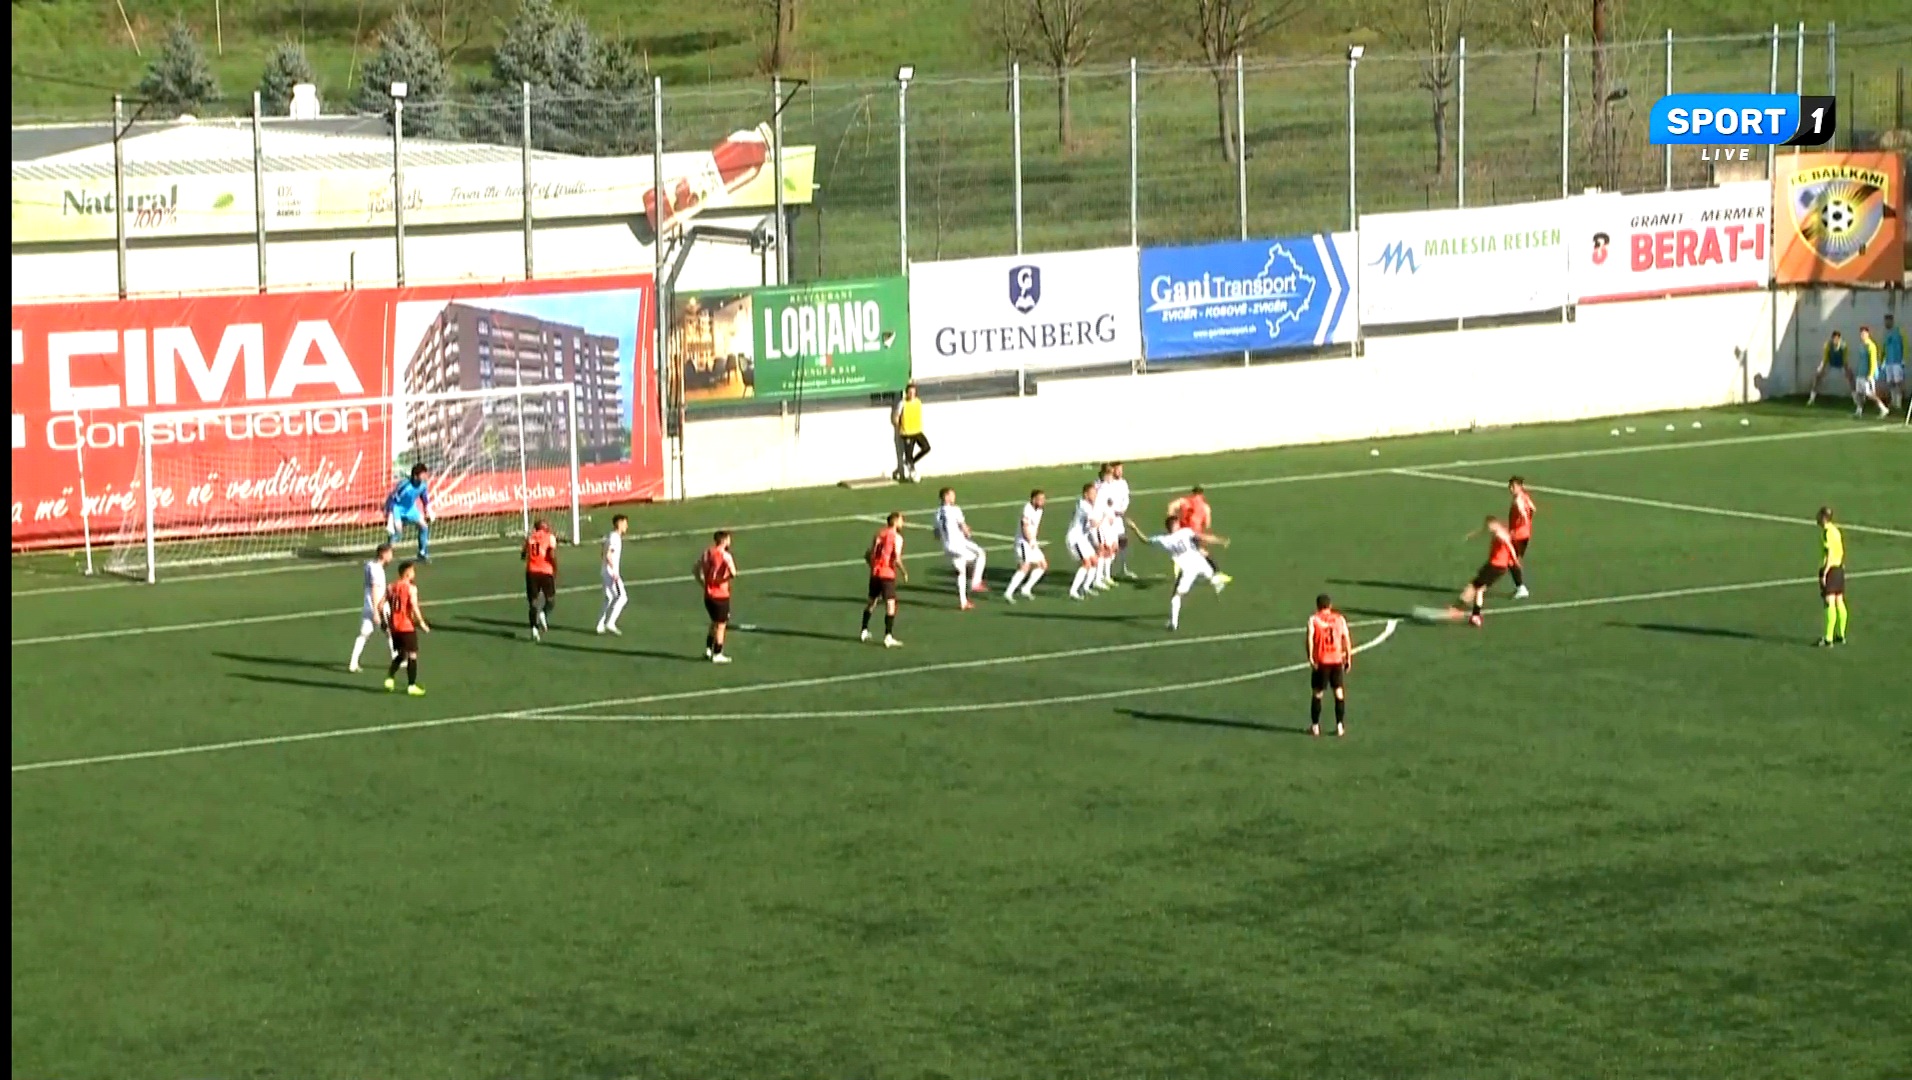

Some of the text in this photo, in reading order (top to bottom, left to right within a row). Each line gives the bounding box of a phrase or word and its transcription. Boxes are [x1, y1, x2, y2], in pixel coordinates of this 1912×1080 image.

[1812, 168, 1884, 186] BALLKANI
[63, 184, 178, 216] Natural
[1631, 206, 1765, 228] GRANIT MERMER
[1424, 228, 1561, 256] MALESIA REISEN
[1631, 223, 1765, 272] BERAT-I
[1150, 271, 1297, 304] Gani Transport
[764, 300, 881, 360] LORIANO
[935, 313, 1116, 356] GUTENBERG
[48, 320, 364, 412] CIMA
[46, 407, 369, 450] Construction
[34, 485, 73, 521] më
[80, 480, 140, 517] mirë
[187, 473, 218, 507] në
[514, 482, 555, 500] Kodra
[568, 474, 632, 496] uharekë
